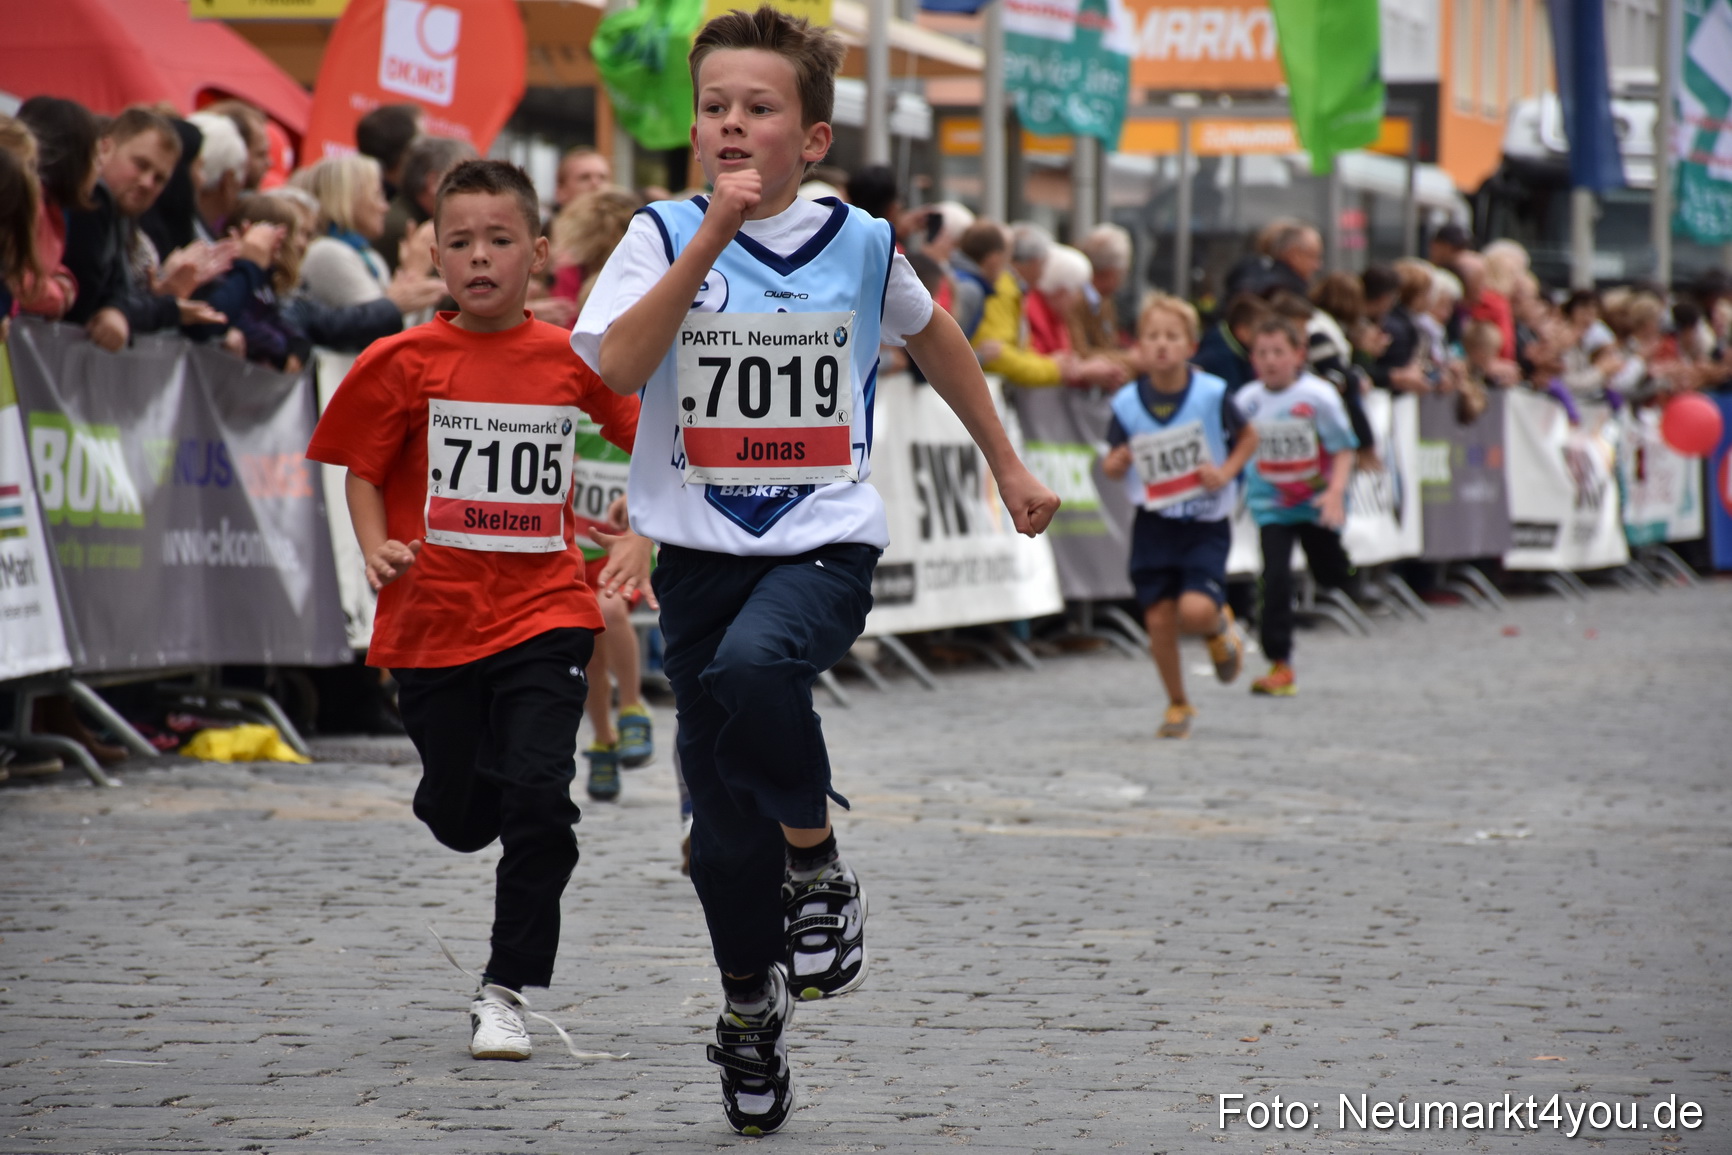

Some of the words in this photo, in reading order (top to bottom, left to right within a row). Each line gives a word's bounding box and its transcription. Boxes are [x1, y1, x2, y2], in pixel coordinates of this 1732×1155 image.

[682, 330, 743, 346] PARTL
[748, 330, 829, 346] Neumarkt
[698, 355, 839, 419] 7019
[432, 414, 483, 431] PARTL
[487, 418, 557, 434] Neumarkt
[736, 437, 806, 461] Jonas
[443, 438, 563, 496] 7105
[464, 507, 542, 532] Skelzen
[807, 882, 829, 891] FILA
[739, 1033, 760, 1042] FILA
